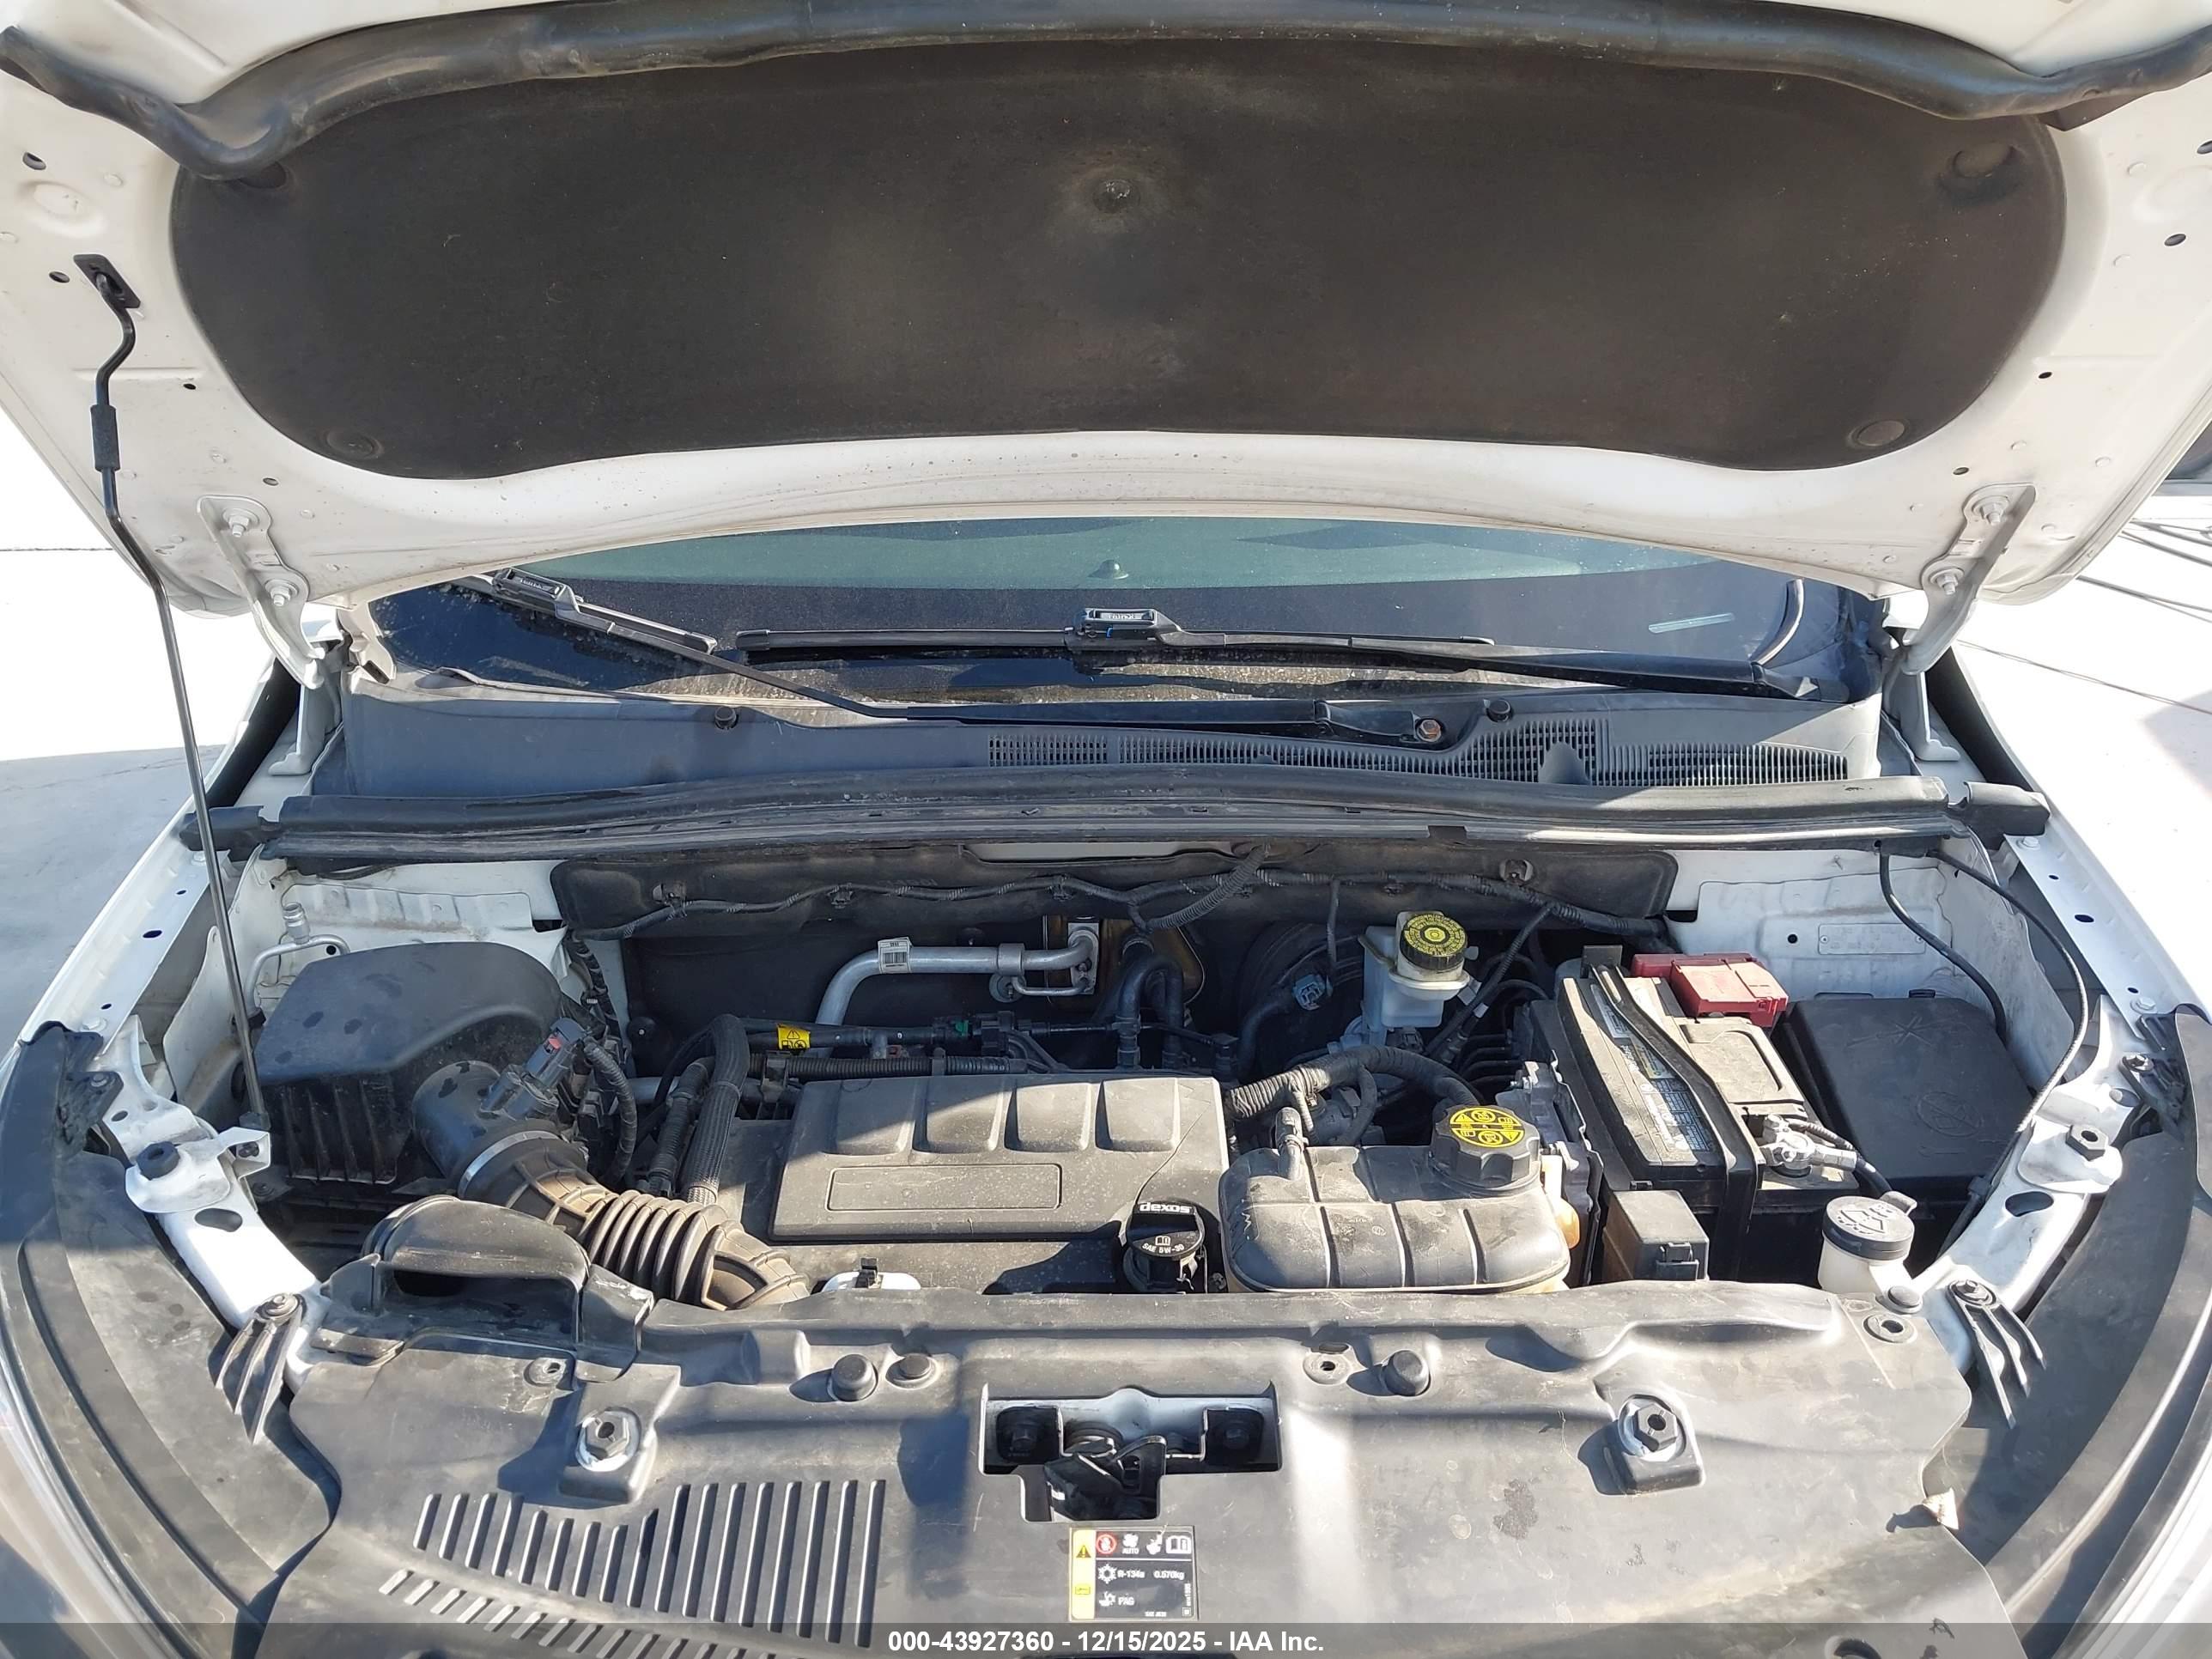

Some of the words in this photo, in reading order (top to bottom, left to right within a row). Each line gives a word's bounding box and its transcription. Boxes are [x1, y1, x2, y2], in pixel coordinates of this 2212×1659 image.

[1139, 1202, 1192, 1213] dexos
[1142, 1243, 1158, 1253] SAE
[1158, 1243, 1185, 1254] 5W-30
[1118, 1596, 1135, 1606] PAG
